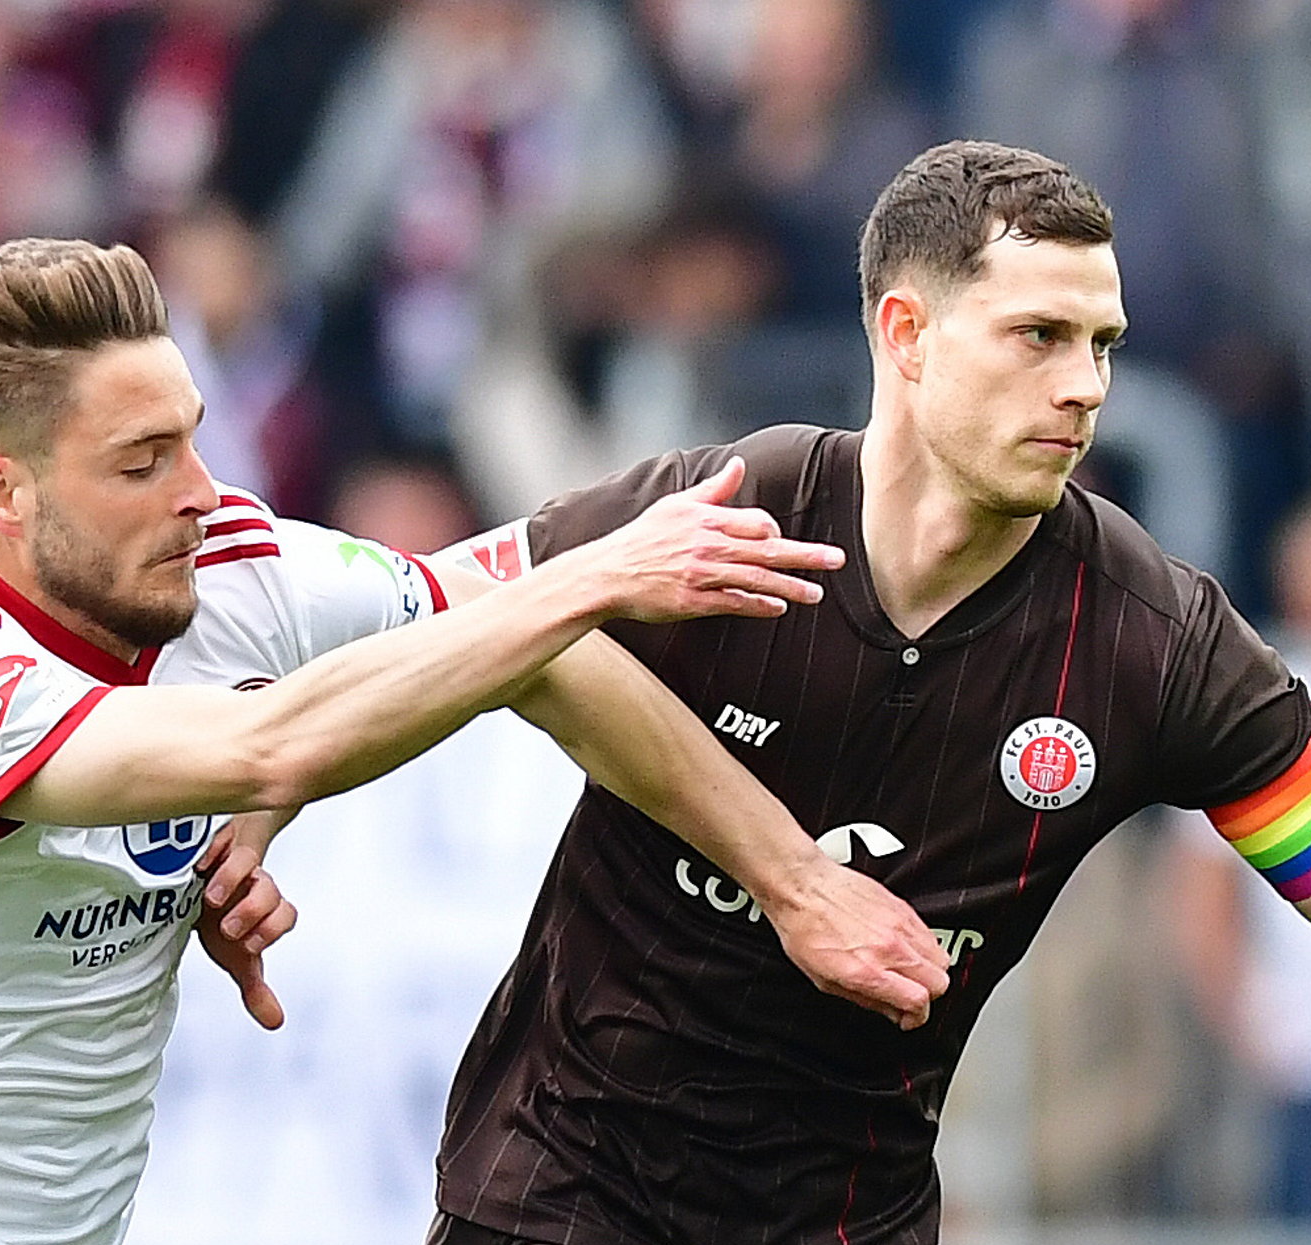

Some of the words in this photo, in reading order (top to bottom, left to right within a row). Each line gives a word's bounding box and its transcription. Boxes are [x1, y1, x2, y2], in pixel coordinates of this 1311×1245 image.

[1006, 738, 1023, 757] FC
[1055, 723, 1092, 768] PAULI
[1024, 791, 1061, 807] 1910
